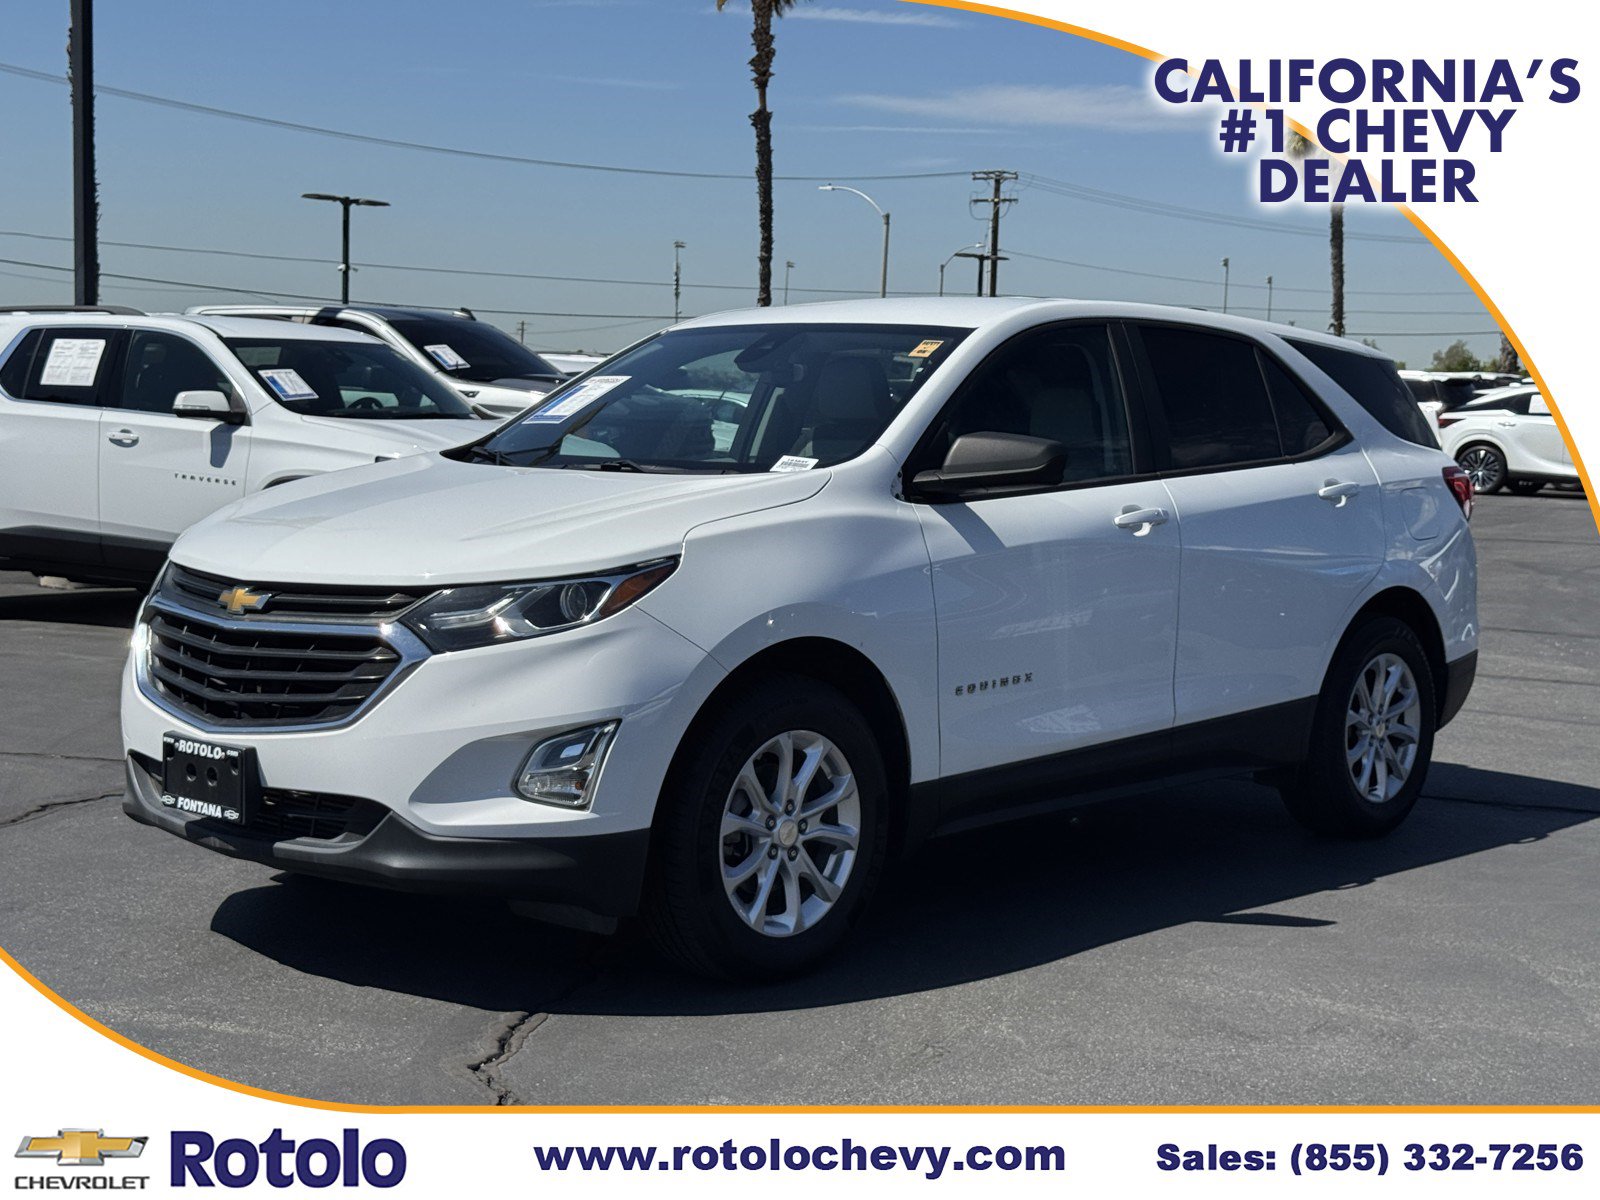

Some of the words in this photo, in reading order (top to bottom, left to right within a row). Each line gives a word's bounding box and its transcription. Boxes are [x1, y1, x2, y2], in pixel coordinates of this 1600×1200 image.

[174, 472, 237, 486] TRAVERSE
[955, 672, 1033, 696] EQUINOX
[177, 796, 223, 819] FONTANA
